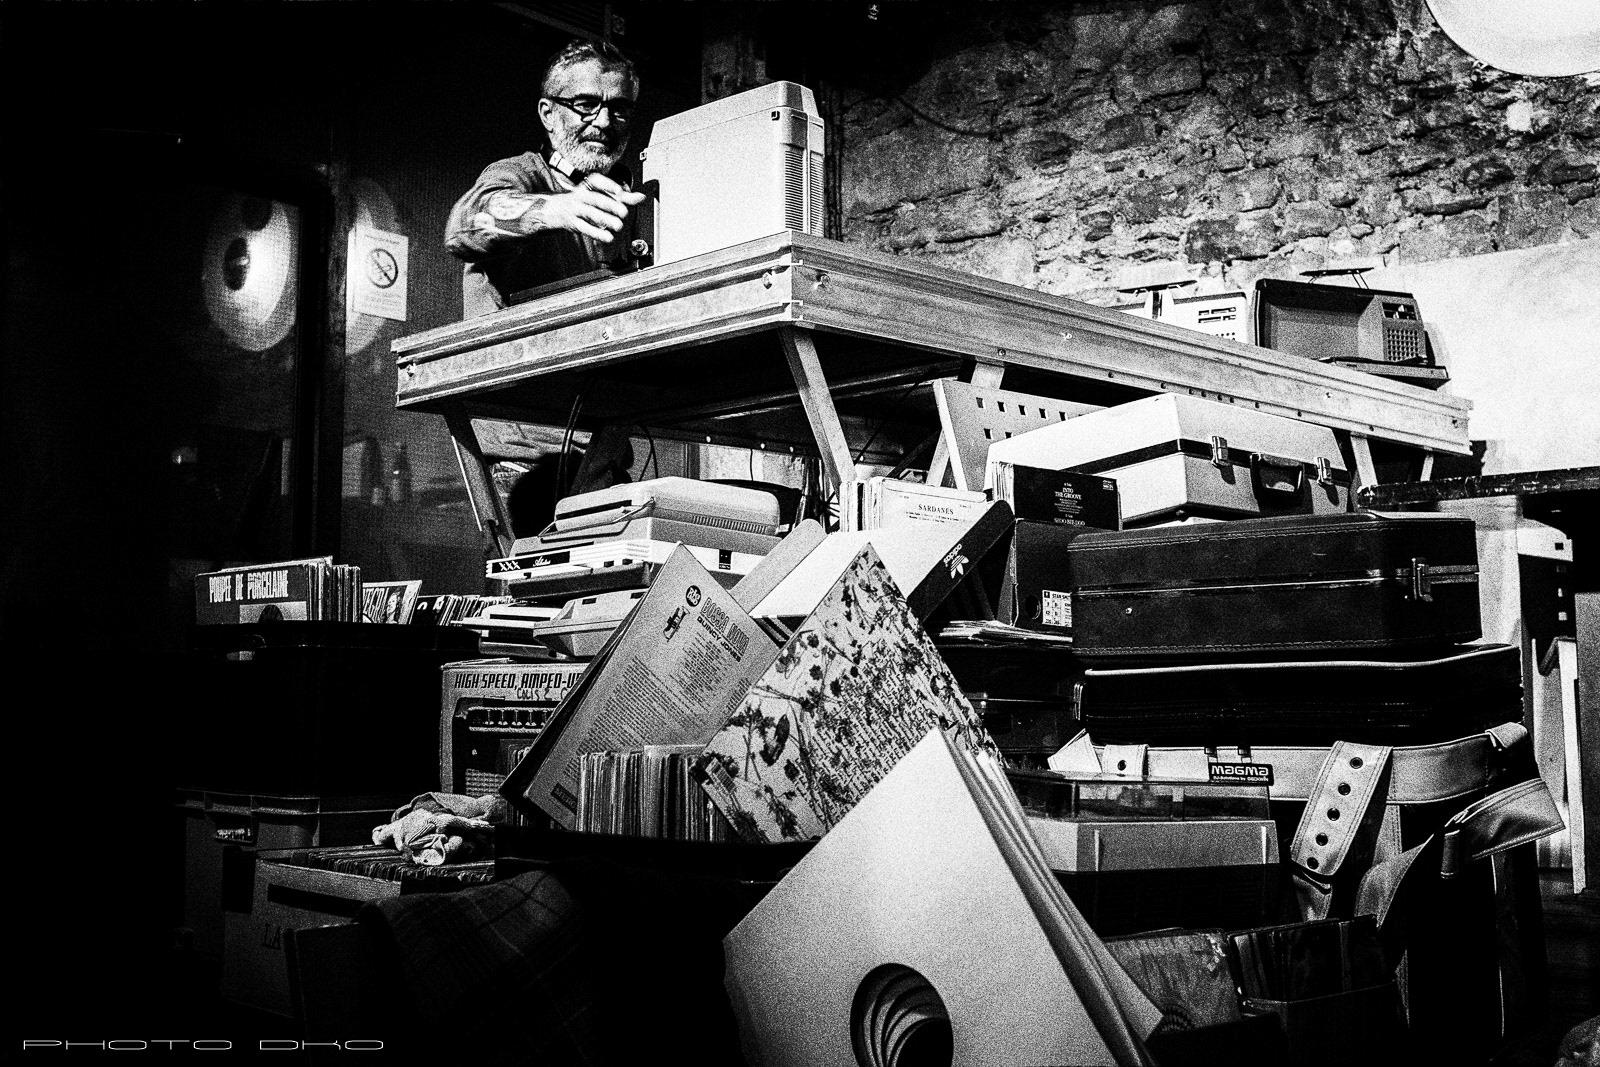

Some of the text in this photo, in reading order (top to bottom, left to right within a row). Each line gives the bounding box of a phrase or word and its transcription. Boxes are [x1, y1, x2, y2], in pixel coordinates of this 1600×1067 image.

[943, 544, 962, 564] adidas
[235, 573, 244, 600] DE
[248, 570, 288, 600] PORCELAINE
[697, 616, 721, 641] QUINCY
[720, 641, 742, 662] JONES
[700, 597, 730, 634] BOSSA
[726, 623, 750, 656] NOVA
[454, 673, 480, 689] HIGH
[480, 673, 518, 690] SPEED,
